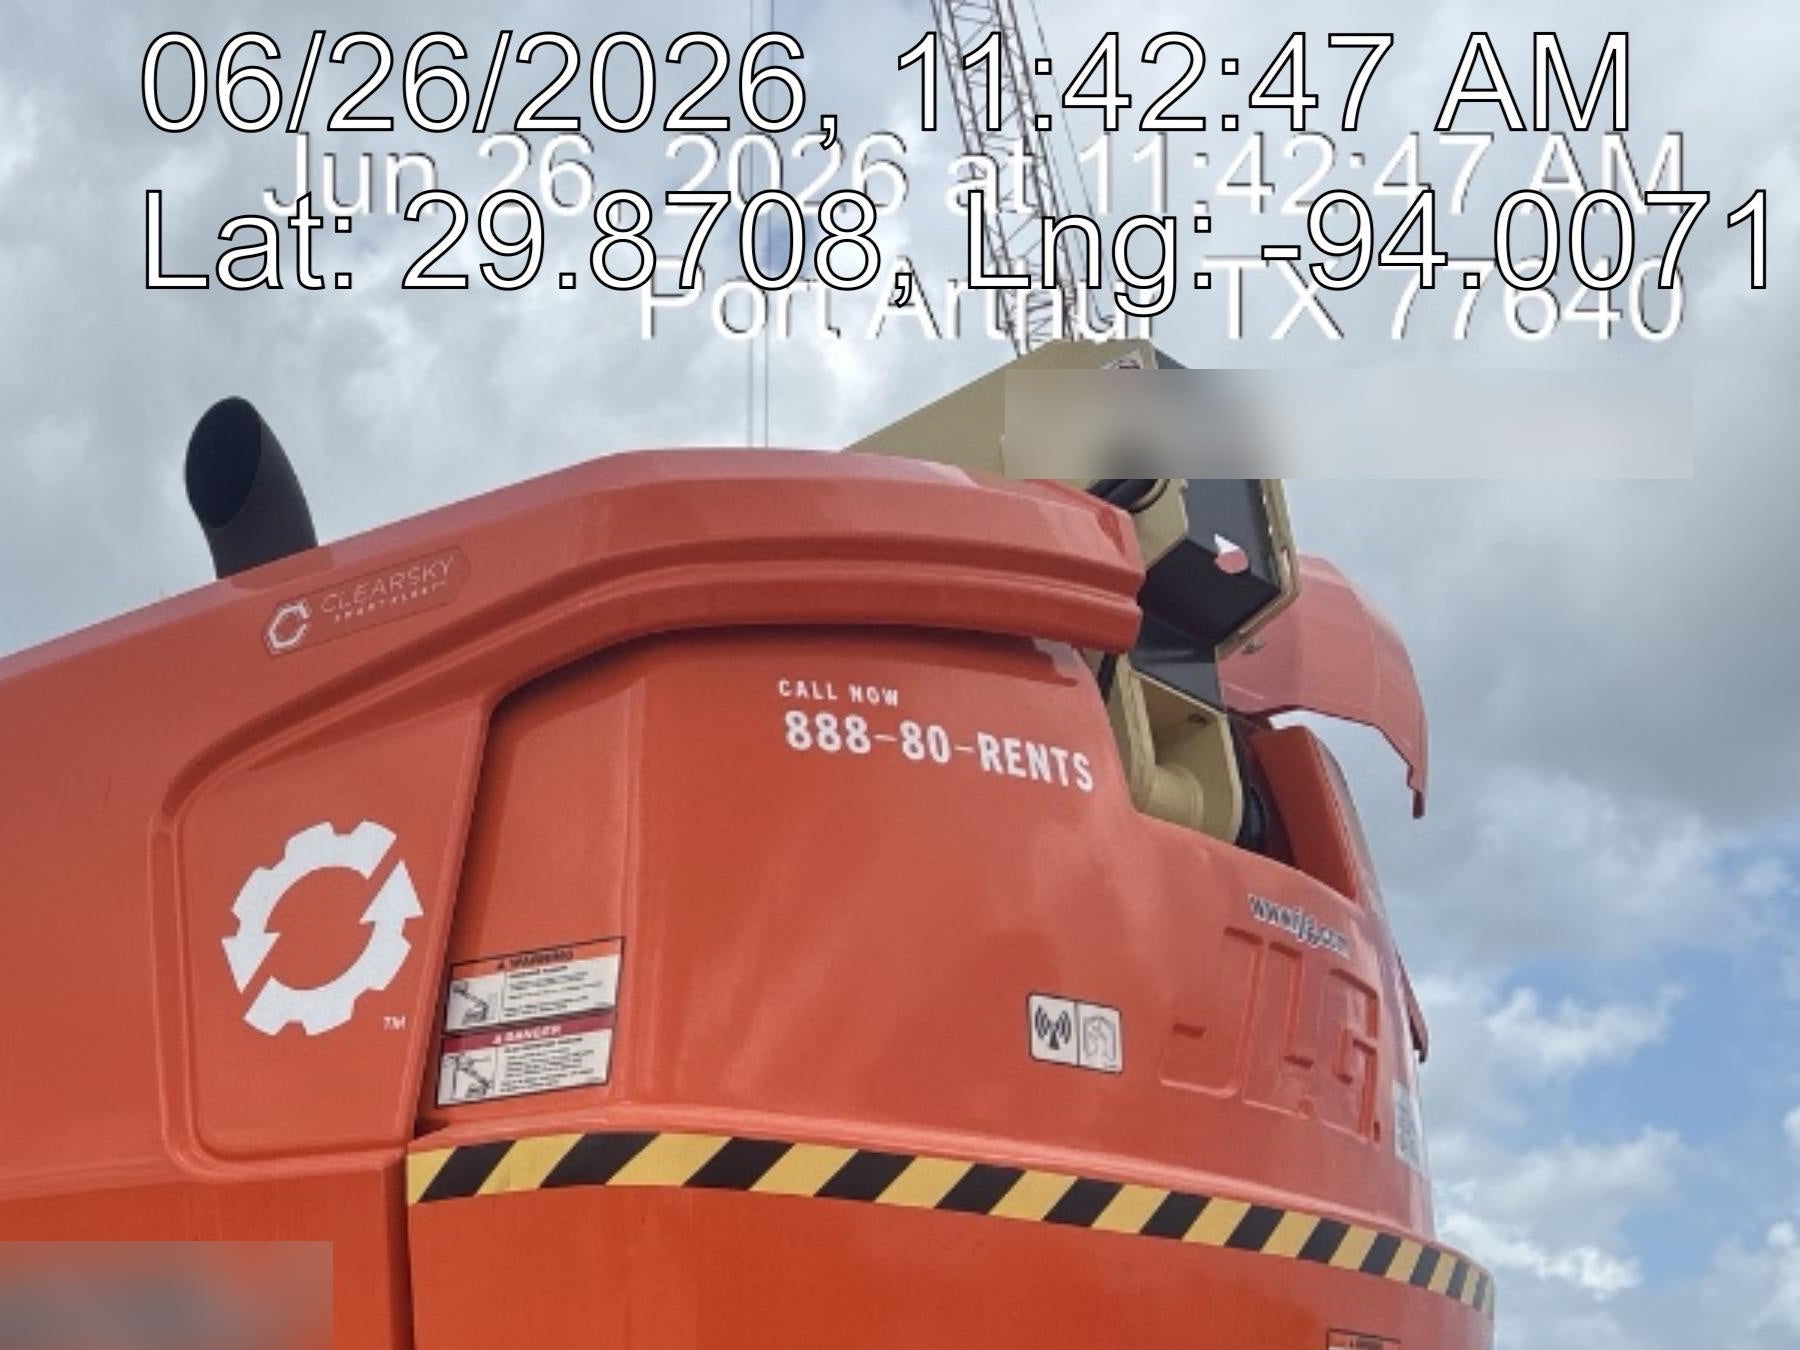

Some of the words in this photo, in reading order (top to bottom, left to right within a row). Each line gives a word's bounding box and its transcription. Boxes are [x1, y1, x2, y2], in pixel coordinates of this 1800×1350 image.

[777, 678, 838, 701] CALL
[848, 684, 899, 706] NOW
[784, 710, 1095, 793] 888-80-RENTS
